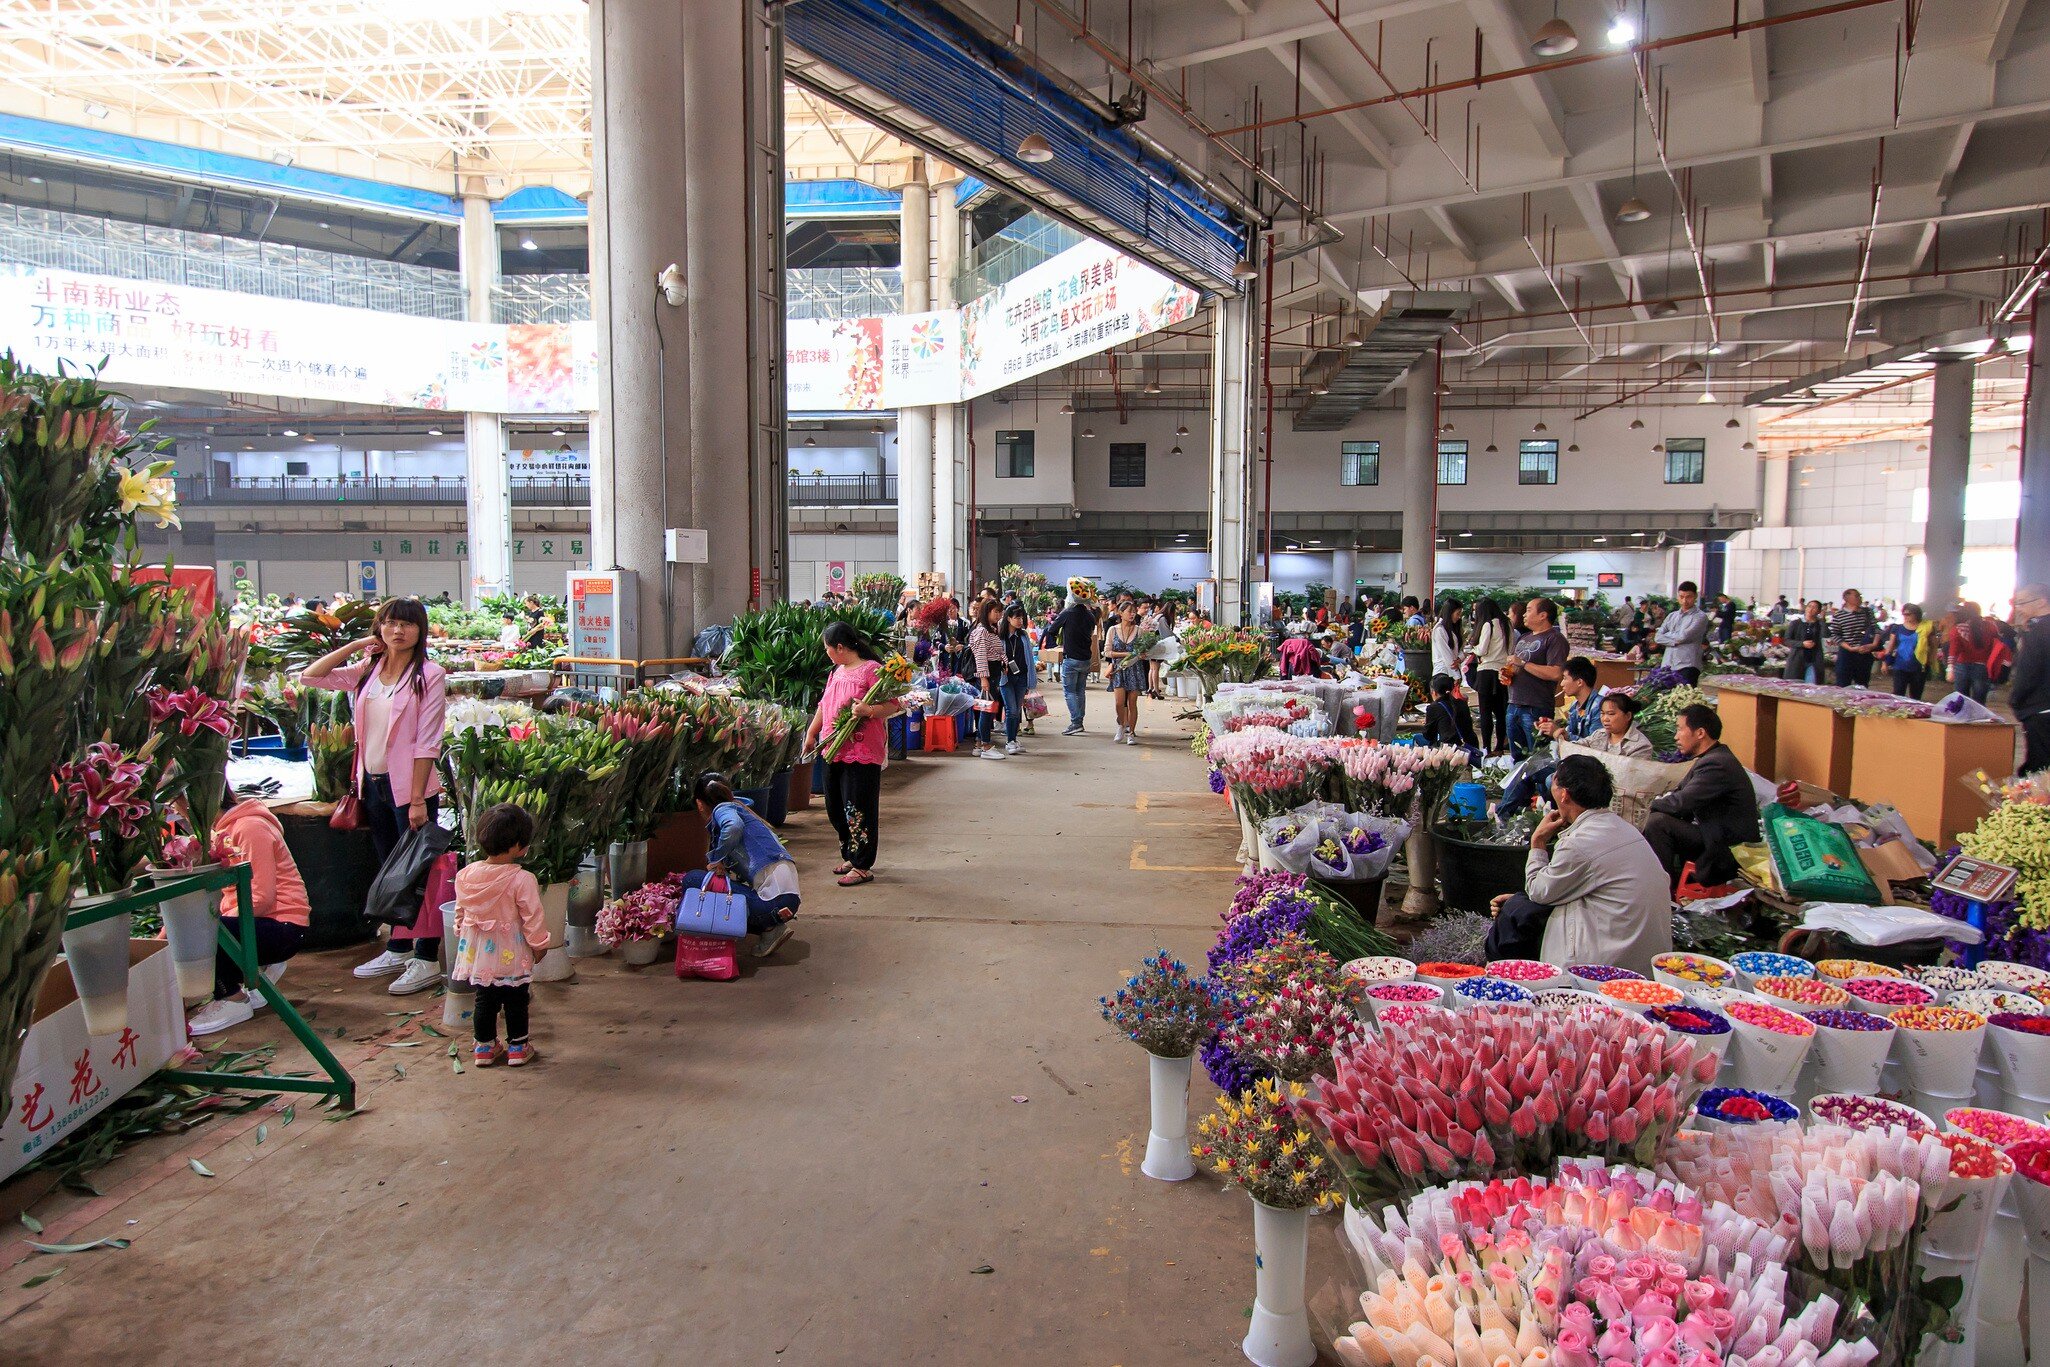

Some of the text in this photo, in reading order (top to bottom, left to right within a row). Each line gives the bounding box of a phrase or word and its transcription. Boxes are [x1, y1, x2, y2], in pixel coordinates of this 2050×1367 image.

[35, 277, 182, 316] 斗南新业态
[170, 319, 280, 353] 好玩好看
[1020, 286, 1118, 347] 斗南花鸟鱼文玩市场
